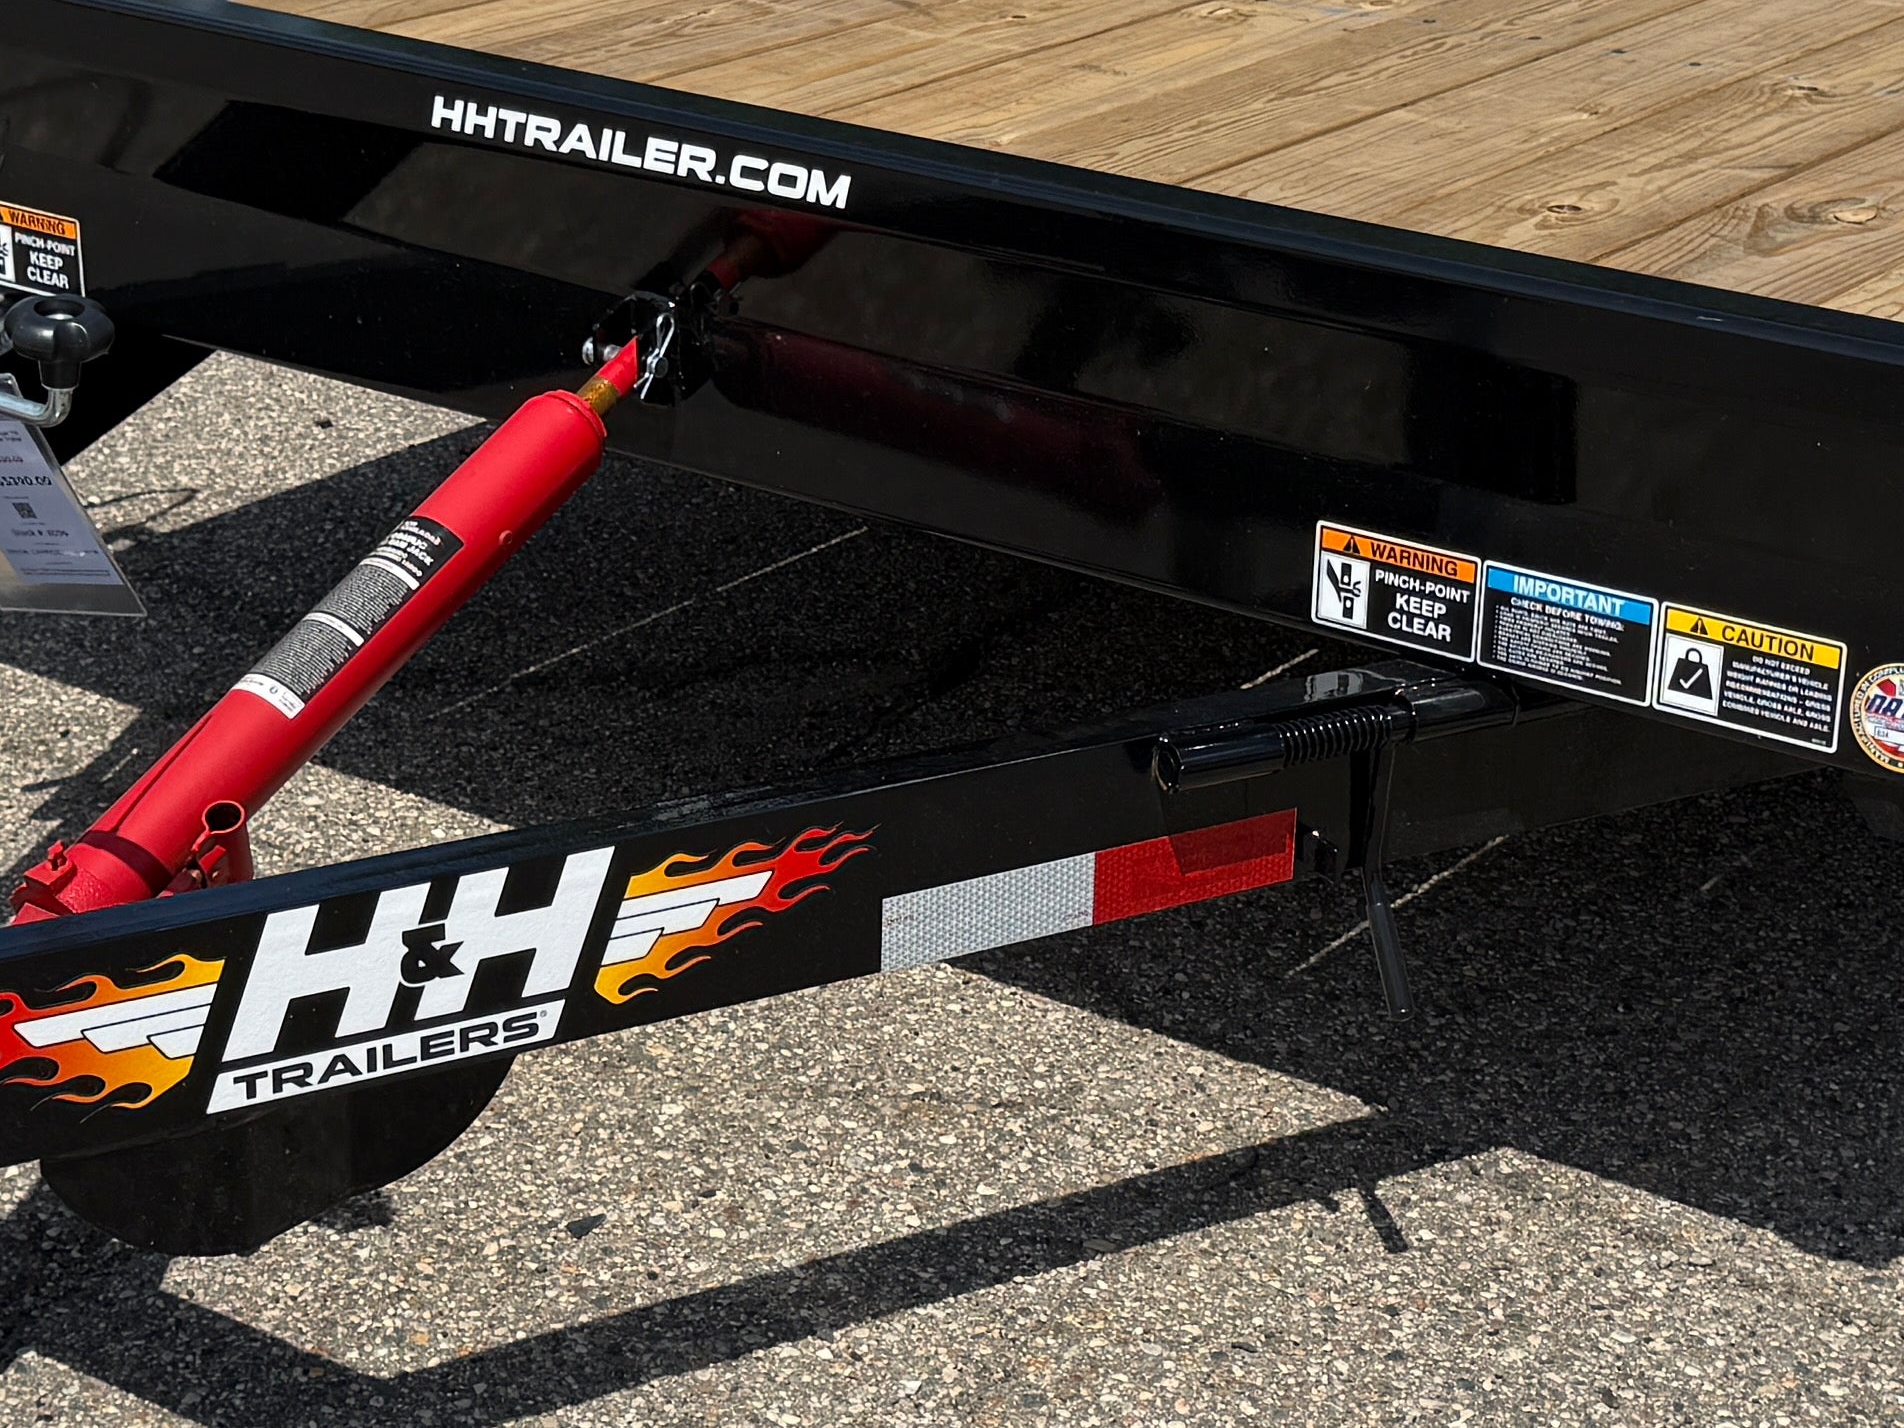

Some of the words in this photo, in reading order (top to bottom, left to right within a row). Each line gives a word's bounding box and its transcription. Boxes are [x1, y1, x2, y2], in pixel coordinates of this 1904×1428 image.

[431, 95, 852, 209] HHTRAILER.COM
[8, 210, 66, 235] WARNING
[29, 251, 63, 270] KEEP
[26, 266, 69, 290] CLEAR
[1370, 542, 1458, 576] WARNING
[1375, 569, 1470, 603] PINCH-POINT
[1513, 574, 1625, 618] IMPORTANT
[1396, 593, 1447, 619] KEEP
[1510, 596, 1543, 612] CHECK
[1545, 605, 1581, 621] BEFORE
[1387, 611, 1452, 642] CLEAR
[1721, 623, 1814, 661] CAUTION
[1764, 658, 1778, 667] NOT
[1780, 662, 1810, 676] EXCEED
[222, 845, 616, 1062] H&H
[231, 1014, 540, 1103] TRAILERS
